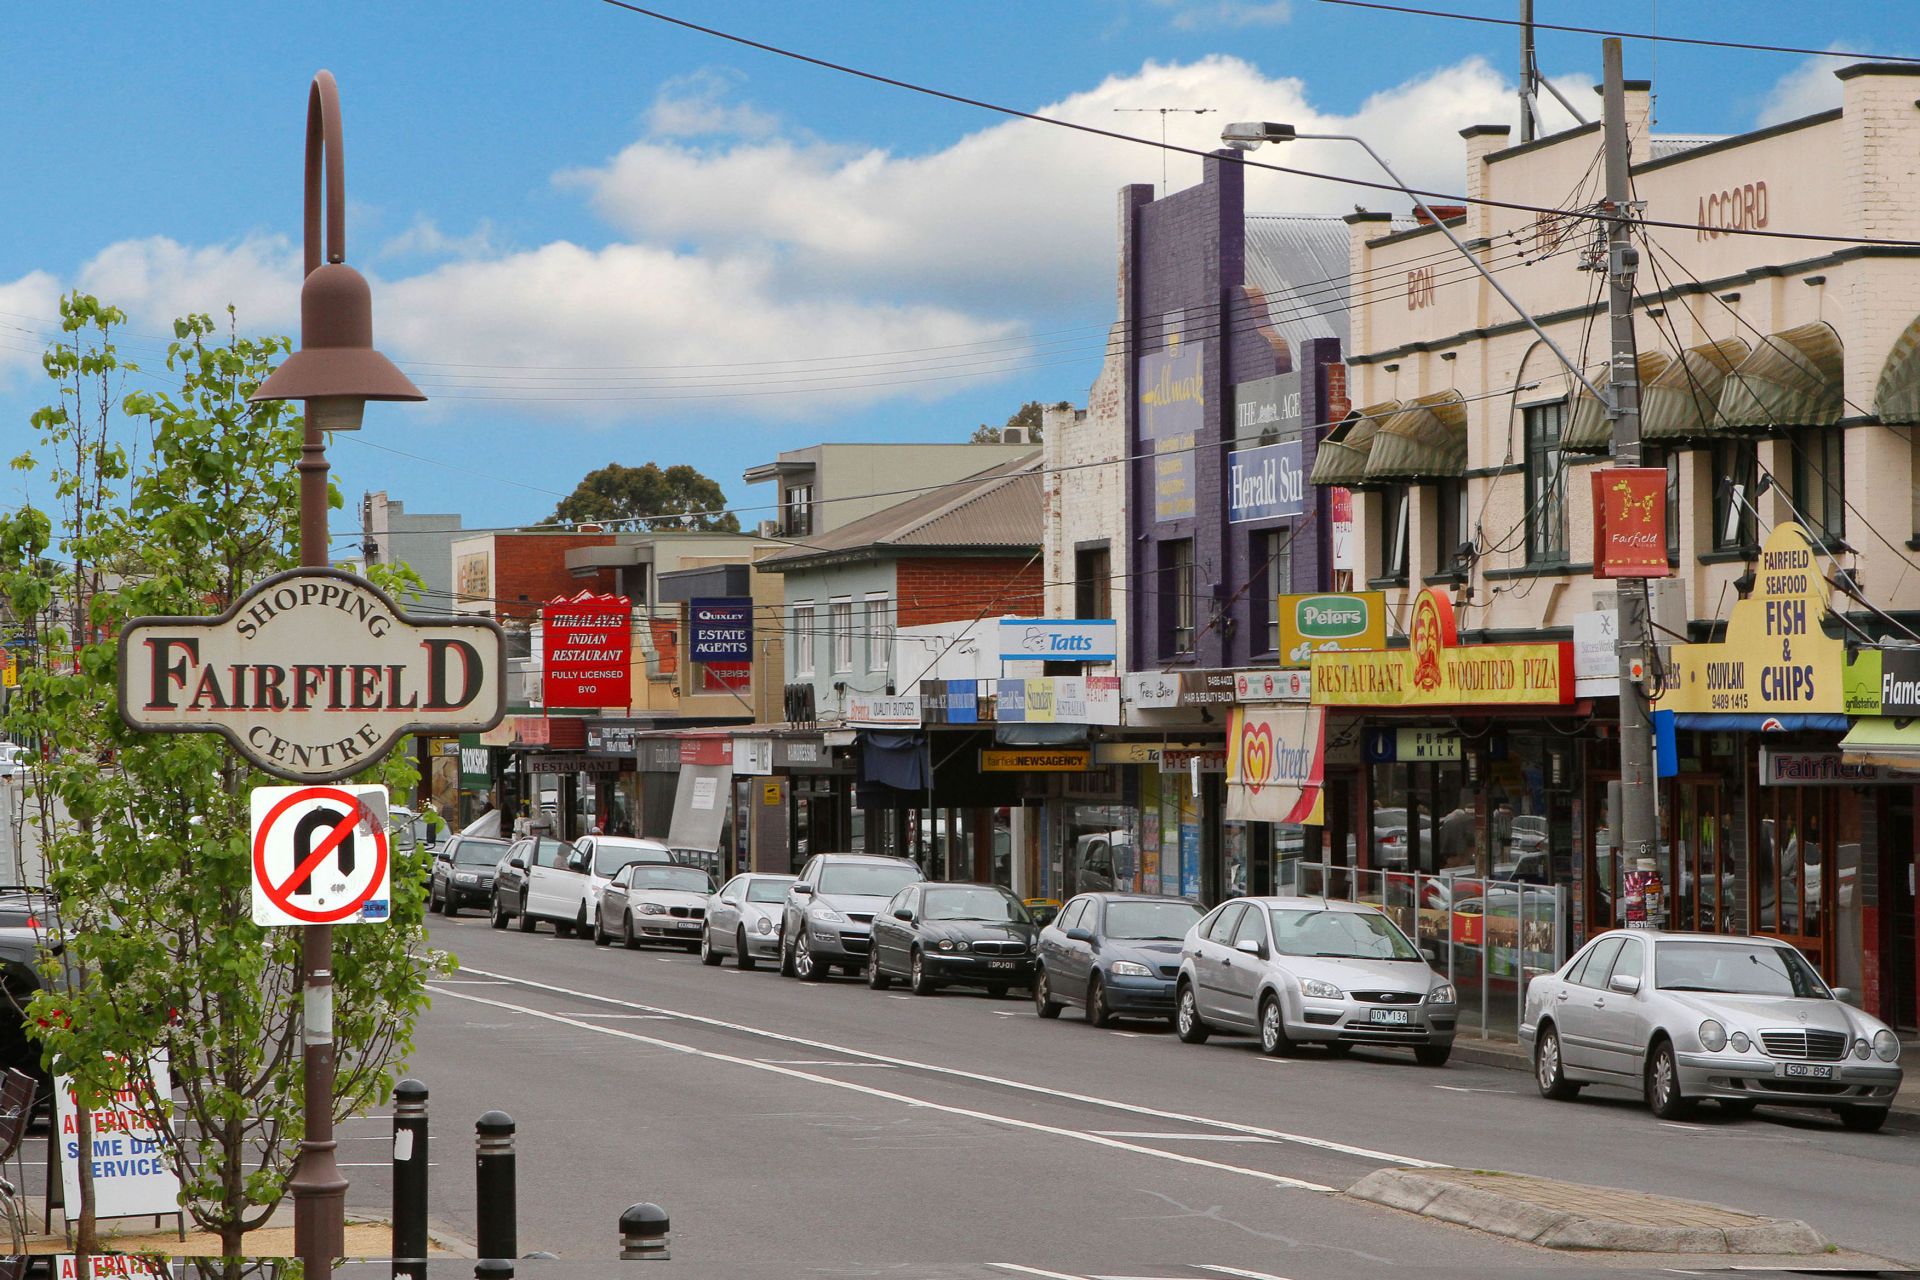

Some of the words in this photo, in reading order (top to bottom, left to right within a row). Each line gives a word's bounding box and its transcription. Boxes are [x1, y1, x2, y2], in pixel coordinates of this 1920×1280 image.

[1697, 181, 1768, 243] ACCORD
[1407, 266, 1435, 311] BON
[1238, 401, 1256, 427] THE
[1281, 392, 1300, 419] AGE
[1232, 456, 1276, 509] Herald
[1612, 531, 1658, 547] Fairfield
[1764, 550, 1809, 570] FAIRFIELD
[1766, 575, 1807, 594] SEAFOOD
[236, 583, 391, 640] SHOPPING
[552, 614, 624, 628] HIMALAYAS
[1304, 606, 1361, 625] Peters
[1766, 600, 1806, 636] FISH
[567, 633, 608, 645] INDIAN
[698, 630, 746, 640] ESTATE
[1049, 633, 1093, 651] Tatts
[552, 650, 624, 661] RESTAURANT
[695, 642, 747, 653] AGENTS
[1783, 637, 1792, 662] &
[142, 636, 484, 713] FAIRFIELD
[551, 671, 578, 679] FULLY
[580, 671, 623, 679] LICENSED
[1317, 663, 1404, 693] RESTAURANT
[1448, 658, 1514, 690] WOODFIRED
[1523, 658, 1557, 689] PIZZA
[1707, 662, 1745, 690] SOUVLAKI
[1760, 665, 1815, 701] CHIPS
[873, 702, 891, 716] QUALITY
[893, 701, 915, 716] BUTCHER
[1712, 694, 1729, 709] 9489
[1731, 693, 1748, 709] 1415
[1845, 696, 1879, 712] grillstation
[249, 724, 382, 767] CENTRE
[1416, 745, 1455, 757] MILK
[533, 761, 612, 772] RESTAURANT
[1273, 738, 1310, 782] Streets
[1813, 1066, 1831, 1077] 894
[67, 1140, 123, 1158] SME
[91, 1158, 163, 1178] ERVICE
